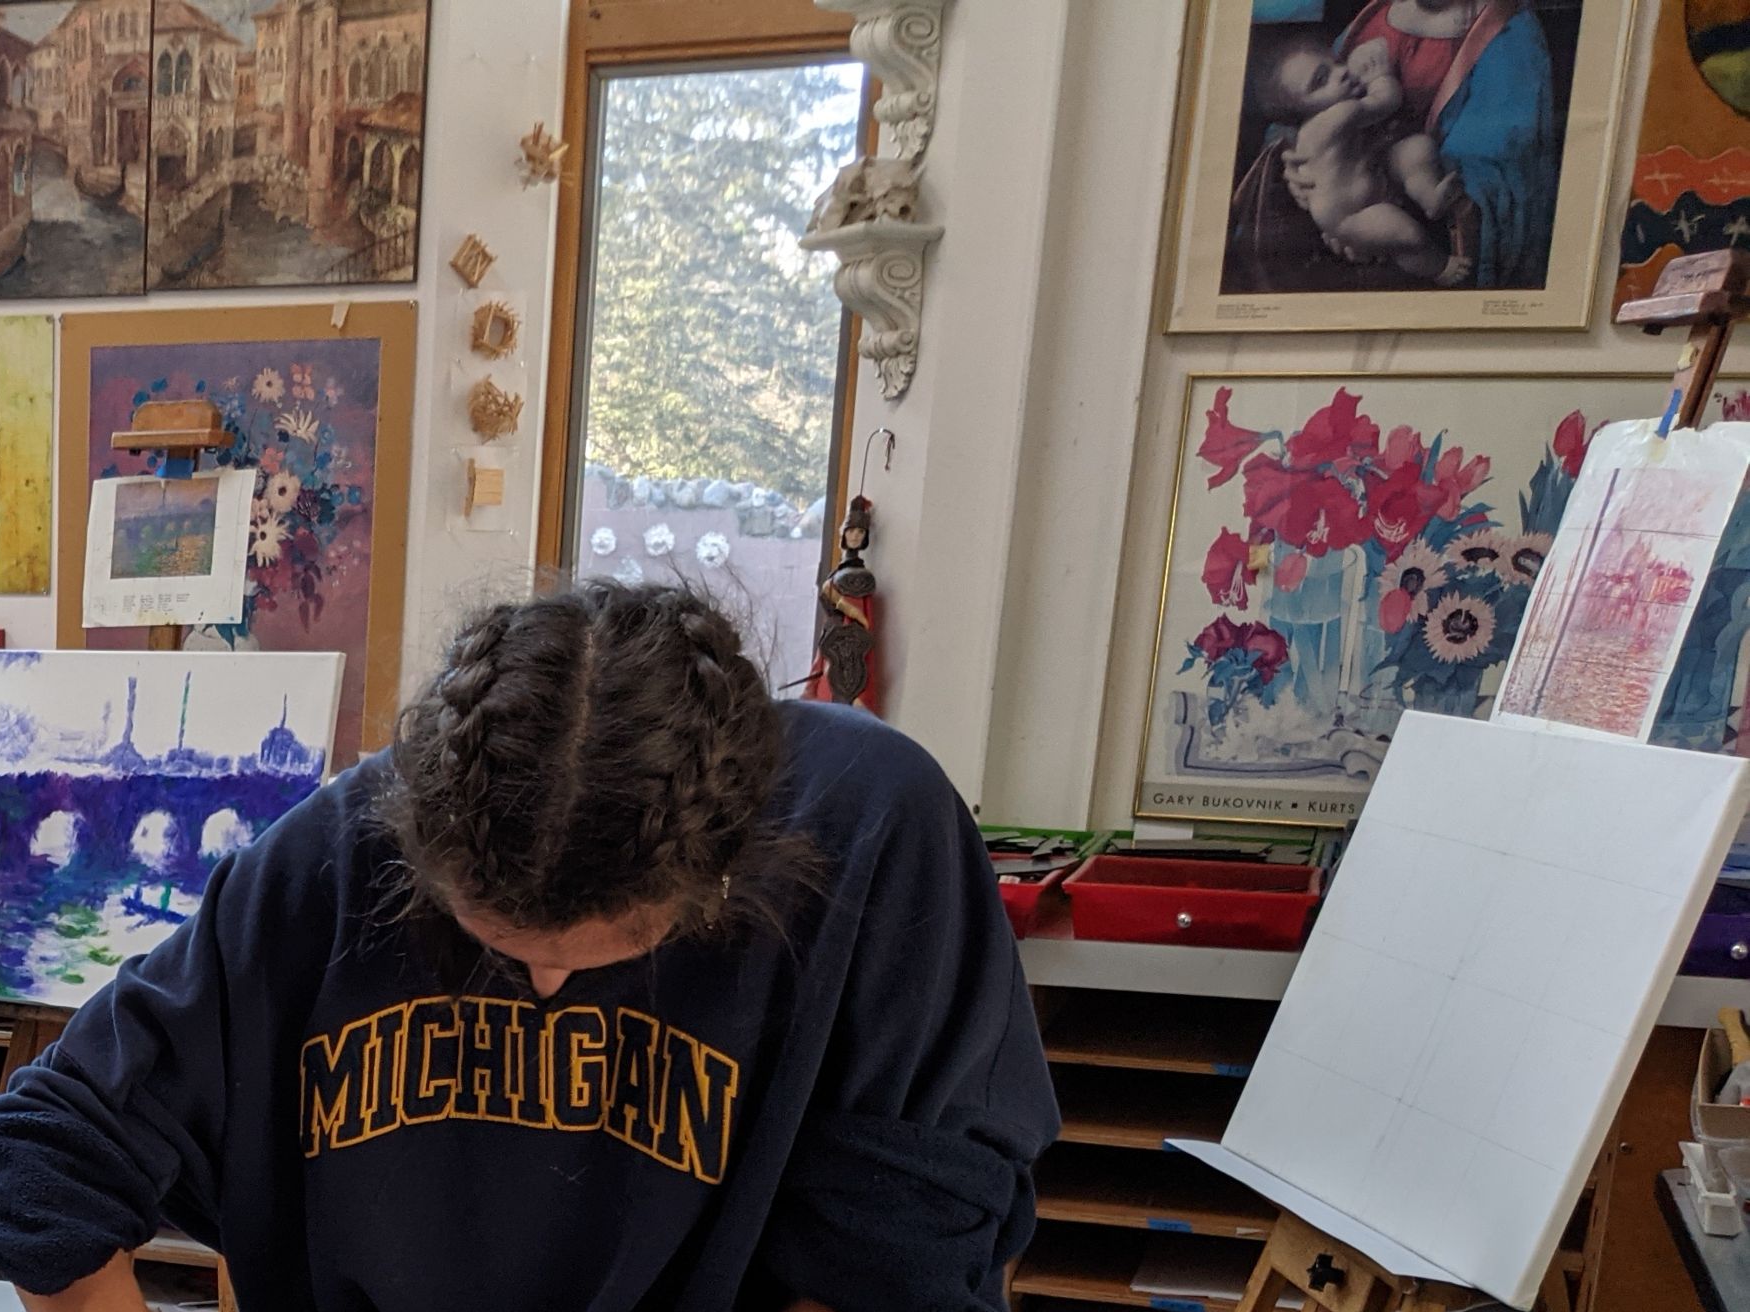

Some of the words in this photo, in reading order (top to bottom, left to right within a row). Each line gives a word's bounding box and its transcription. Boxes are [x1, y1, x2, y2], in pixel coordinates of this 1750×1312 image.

[1153, 792, 1194, 806] GARY
[1202, 795, 1283, 810] BUKOVNIK
[1307, 801, 1355, 814] KURTS
[300, 995, 739, 1185] MICHIGAN
